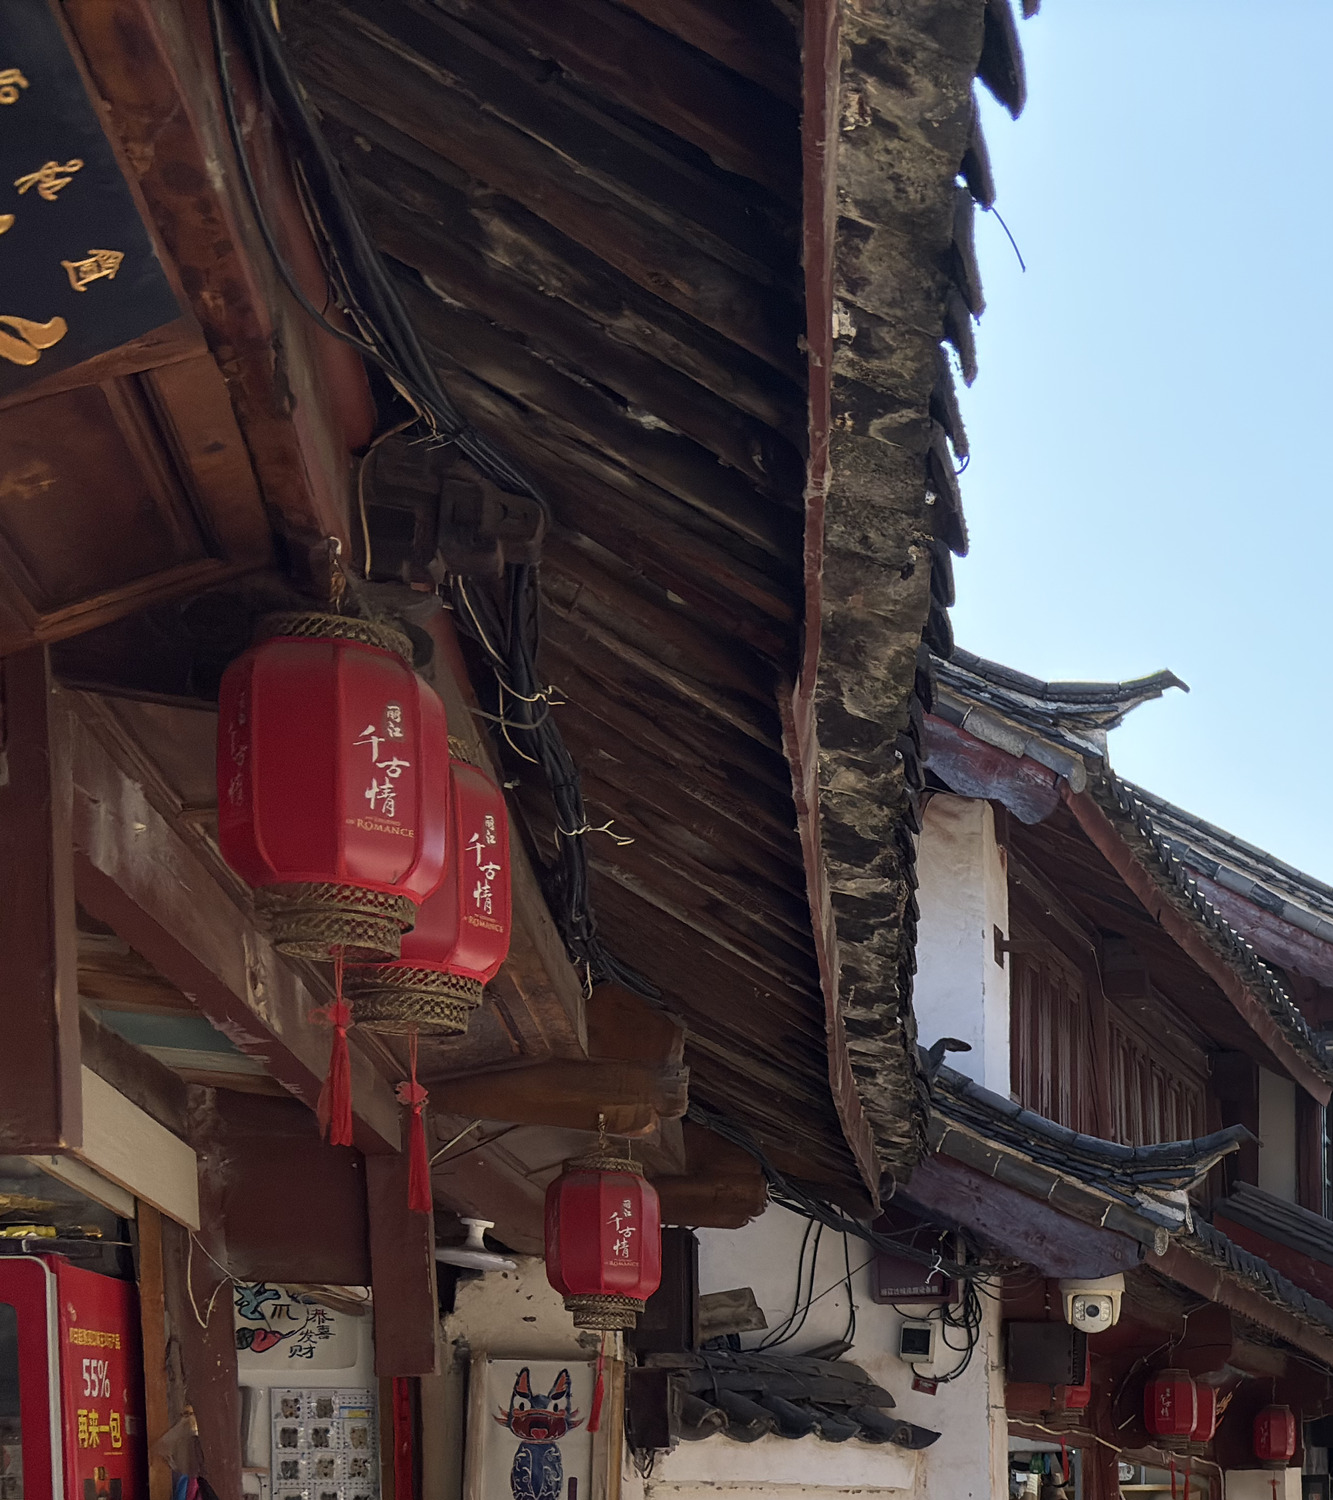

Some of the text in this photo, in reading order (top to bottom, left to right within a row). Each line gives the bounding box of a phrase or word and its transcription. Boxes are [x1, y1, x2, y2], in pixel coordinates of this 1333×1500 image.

[386, 705, 403, 738] 丽江
[352, 724, 410, 818] 千古情
[465, 832, 501, 915] 千古情
[606, 1211, 636, 1258] 千古情
[82, 1358, 111, 1398] 55%
